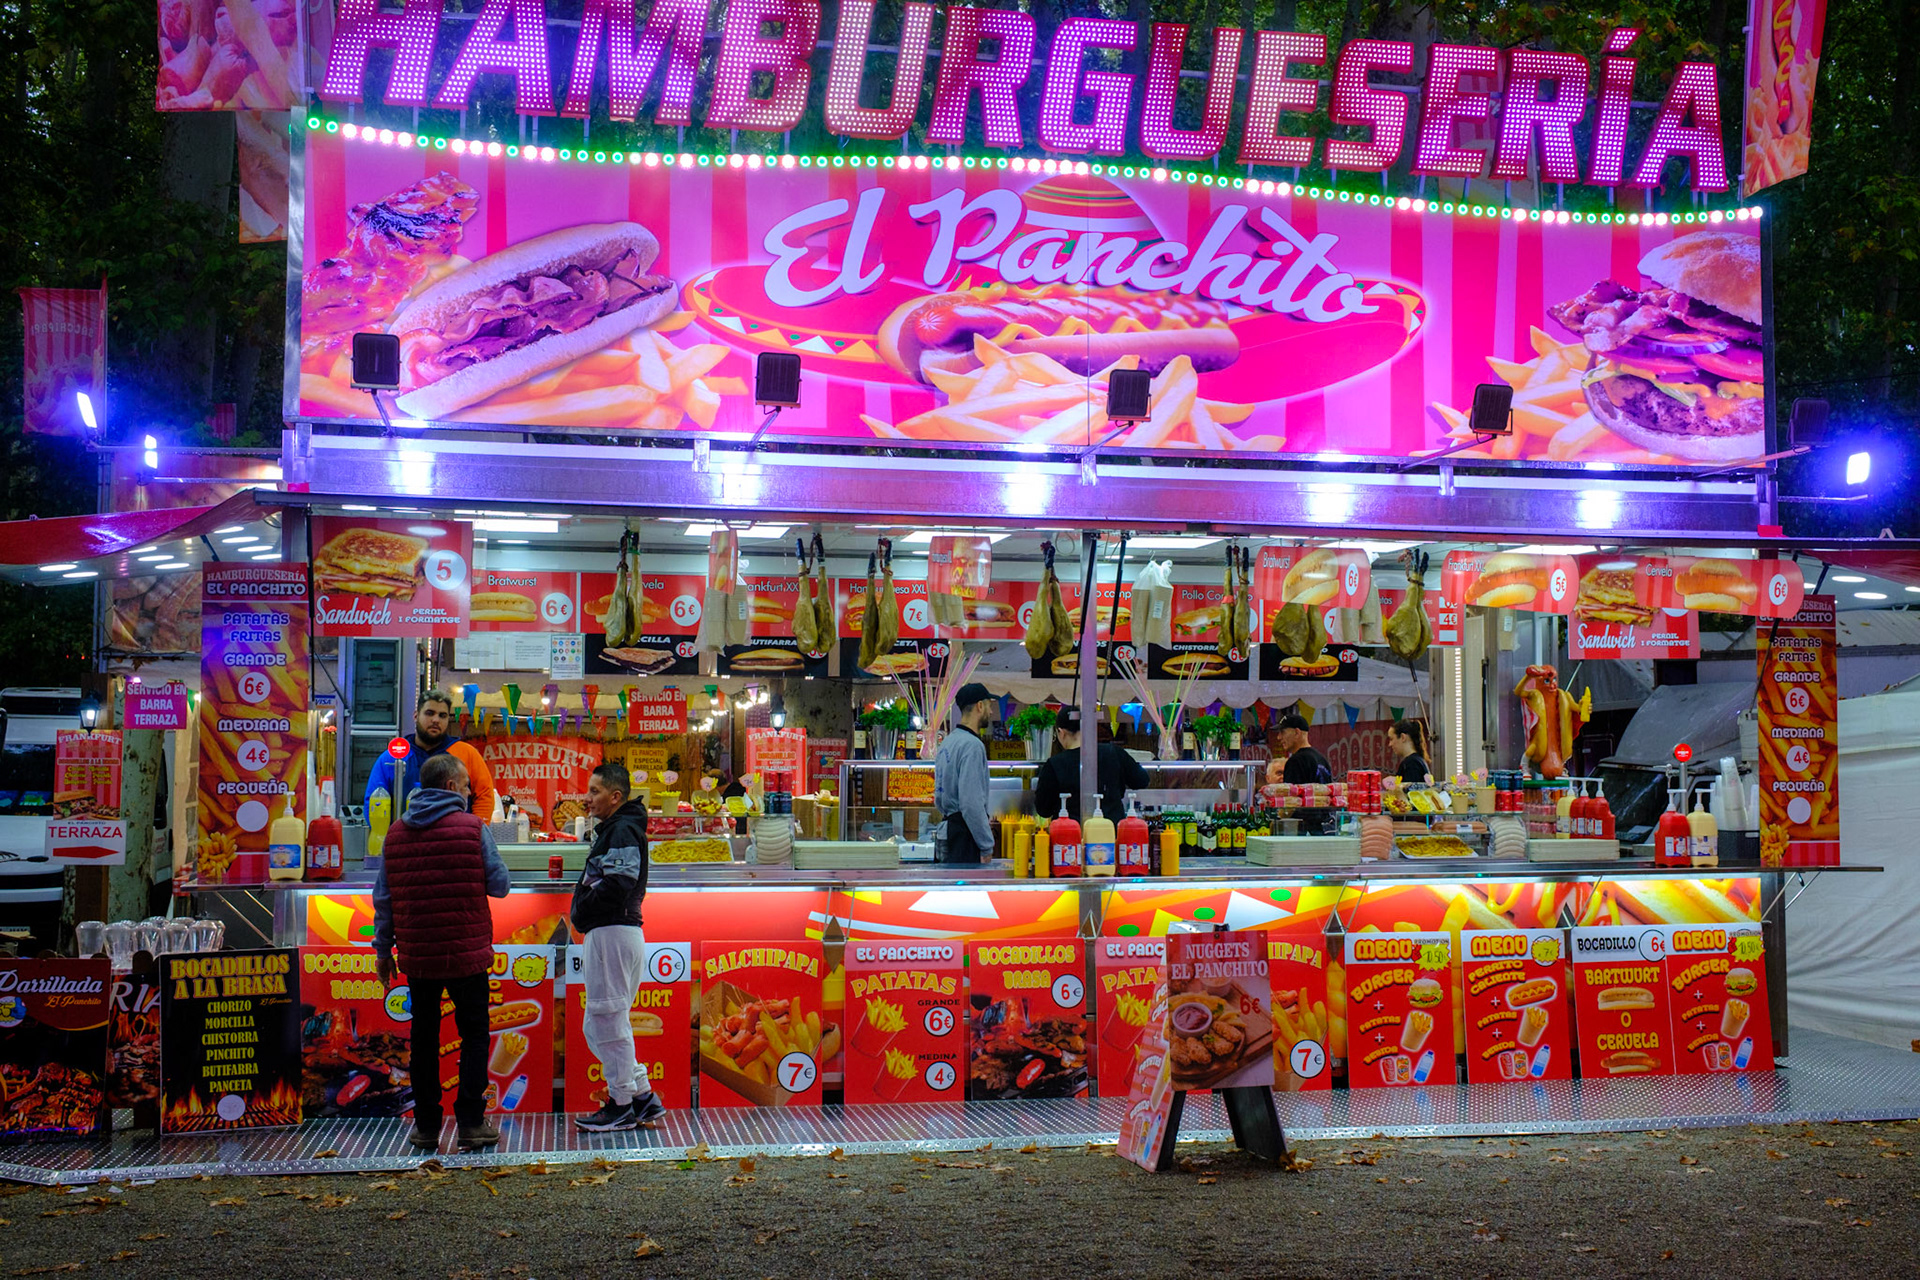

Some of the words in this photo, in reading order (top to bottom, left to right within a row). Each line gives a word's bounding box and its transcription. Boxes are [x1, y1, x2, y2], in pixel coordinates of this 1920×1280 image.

[764, 188, 885, 307] El
[1263, 551, 1291, 570] Bratwurst
[1448, 557, 1473, 572] Frankfurt
[207, 569, 306, 581] HAMBURGUESERÍA
[436, 559, 452, 581] 5
[1645, 563, 1674, 577] Cervela
[487, 574, 538, 587] Bratwurst
[1348, 570, 1359, 588] 6€
[1555, 576, 1567, 593] 5€
[207, 583, 226, 595] EL
[229, 582, 306, 595] PANCHITO
[911, 584, 927, 594] XXL
[1182, 590, 1204, 600] Pollo
[1774, 582, 1787, 598] 6€
[315, 595, 392, 625] Sandwich
[412, 608, 448, 616] PERNIL
[544, 600, 568, 618] 6€
[673, 601, 696, 619] 6€
[908, 608, 923, 622] 7€
[223, 612, 290, 625] PATATAS
[405, 616, 461, 624] FORMATGE
[230, 631, 281, 642] FRITAS
[1577, 623, 1636, 649] Sandwich
[1772, 637, 1822, 648] PATATAS
[678, 642, 694, 657] 6€
[930, 643, 945, 656] 6€
[1117, 646, 1132, 660] 6€
[1341, 650, 1355, 662] 6€
[1778, 652, 1816, 662] FRITAS
[223, 653, 287, 667] GRANDE
[1774, 672, 1820, 683] GRANDE
[173, 683, 187, 695] EN
[244, 677, 265, 695] 6€
[674, 691, 687, 701] EN
[1790, 692, 1805, 707] 6€
[140, 699, 173, 711] BARRA
[643, 705, 675, 716] BARRA
[134, 714, 178, 726] TERRAZA
[217, 718, 290, 732] MEDIANA
[638, 720, 679, 731] TERRAZA
[1771, 727, 1825, 739] MEDIANA
[245, 748, 267, 763] 4€
[483, 742, 595, 770] ANKFURT
[1793, 752, 1810, 764] 4€
[494, 763, 572, 779] PANCHITO
[217, 778, 289, 795] PEQUEÑA
[1772, 779, 1825, 792] PEQUEÑA
[48, 826, 123, 838] TERRAZA
[1471, 935, 1528, 957] MENU
[1577, 936, 1637, 952] BOCADILLO
[1673, 930, 1727, 952] MENU
[857, 946, 874, 961] EL
[879, 946, 954, 961] PANCHITO
[978, 945, 1075, 966] BOCADILLOS
[1106, 943, 1125, 957] EL
[1186, 942, 1250, 960] NUGGETS
[1354, 939, 1413, 961] MENU
[170, 954, 291, 979] BOCADILLOS
[657, 954, 682, 977] 6€
[705, 947, 819, 979] SALCHIPAPA
[1171, 963, 1191, 980] EL
[1194, 960, 1268, 979] PANCHITO
[1003, 969, 1052, 990] BRASA
[1468, 959, 1524, 984] PERRITO
[1585, 967, 1660, 985] BARTWURT
[1672, 958, 1730, 992] BURGER
[173, 980, 190, 999] A
[193, 977, 218, 998] LA
[222, 974, 288, 996] BRASA
[330, 980, 385, 999] BRASA
[851, 970, 957, 999] PATATAS
[1060, 982, 1082, 1000] 6€
[1350, 969, 1415, 1003] BURGER
[1470, 971, 1526, 996] CALIENTE
[207, 1000, 252, 1014] CHORIZO
[917, 998, 961, 1007] GRANDE
[1240, 994, 1260, 1015] 6€
[929, 1011, 952, 1032] 6€
[1477, 1010, 1518, 1030] PATATAS
[1620, 1011, 1632, 1028] O
[1681, 1004, 1720, 1024] PATATAS
[205, 1016, 255, 1029] MORCILLA
[1359, 1015, 1401, 1034] PATATAS
[202, 1031, 259, 1046] CHISTORRA
[206, 1047, 255, 1061] PINCHITO
[918, 1053, 958, 1061] MEDINA
[1363, 1045, 1399, 1065] BEBIDA
[1482, 1040, 1516, 1060] BEBIDA
[1297, 1048, 1323, 1072] 7€
[202, 1062, 259, 1078] BUTIFARRA
[788, 1062, 813, 1087] 7€
[934, 1067, 954, 1086] 4€
[209, 1078, 253, 1093] PANCETA
